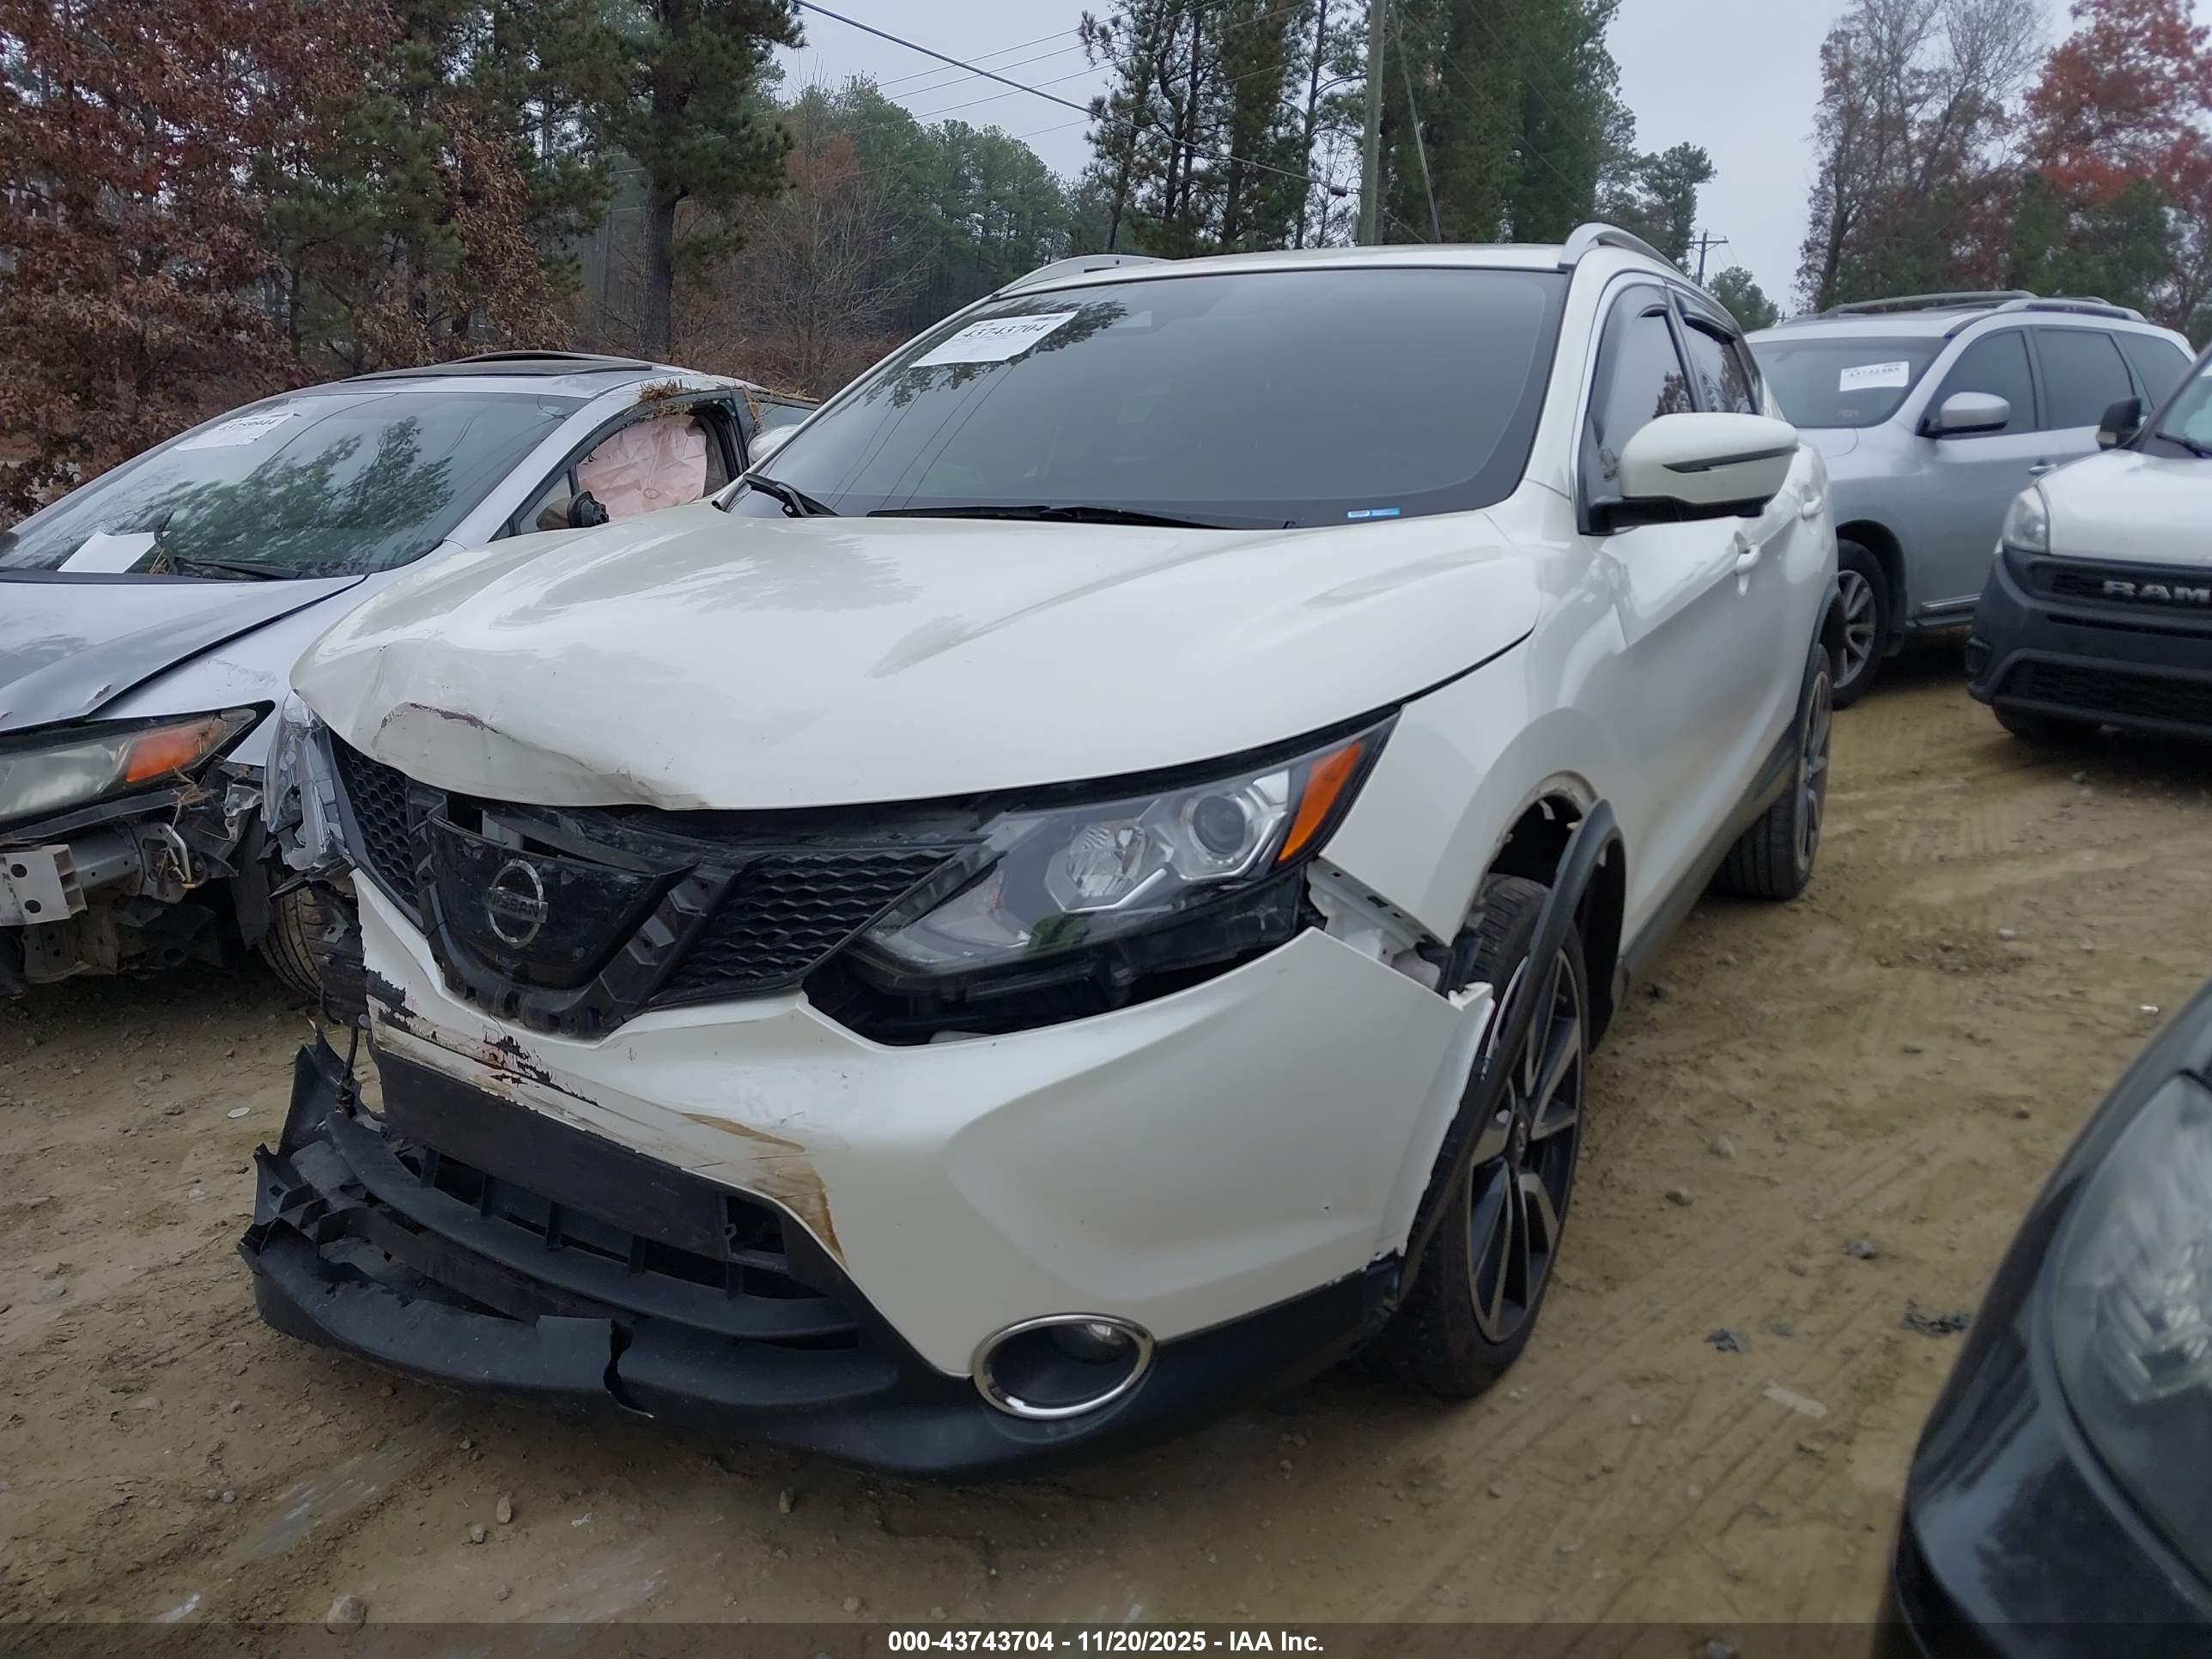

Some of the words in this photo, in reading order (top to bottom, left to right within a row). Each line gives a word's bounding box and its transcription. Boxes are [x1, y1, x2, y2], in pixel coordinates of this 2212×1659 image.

[962, 323, 1049, 338] 43743704
[2103, 580, 2212, 601] RAM
[488, 890, 543, 921] NISSAN
